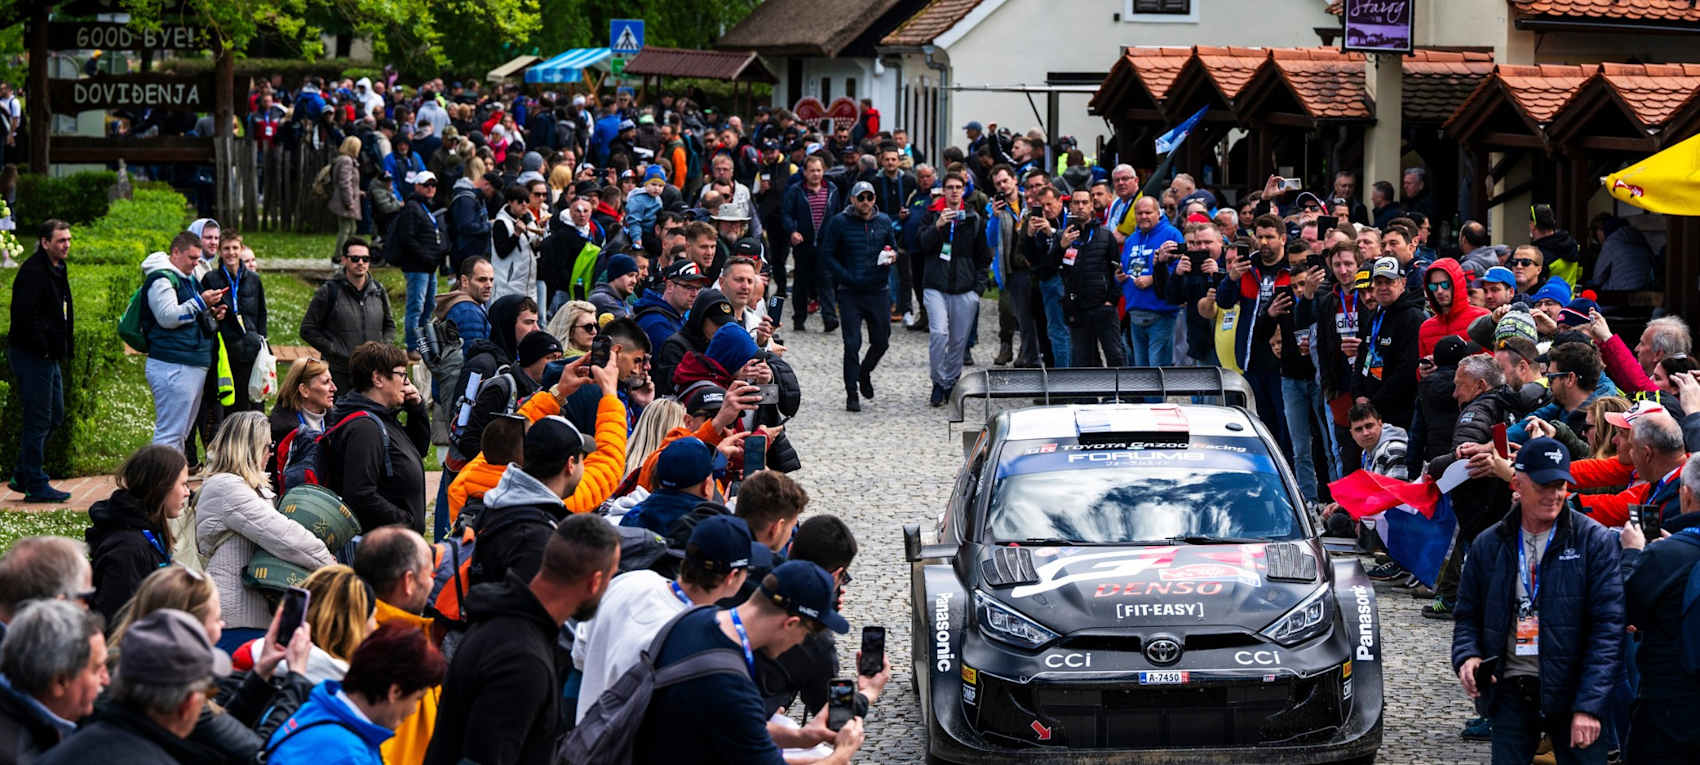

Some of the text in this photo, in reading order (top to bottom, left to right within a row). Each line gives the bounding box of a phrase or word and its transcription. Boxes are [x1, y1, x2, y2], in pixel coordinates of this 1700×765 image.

[73, 83, 200, 104] DOVIĐENJA
[1062, 442, 1126, 451] TOYOTA
[1094, 581, 1222, 598] DENSO
[936, 592, 955, 673] Panasonic
